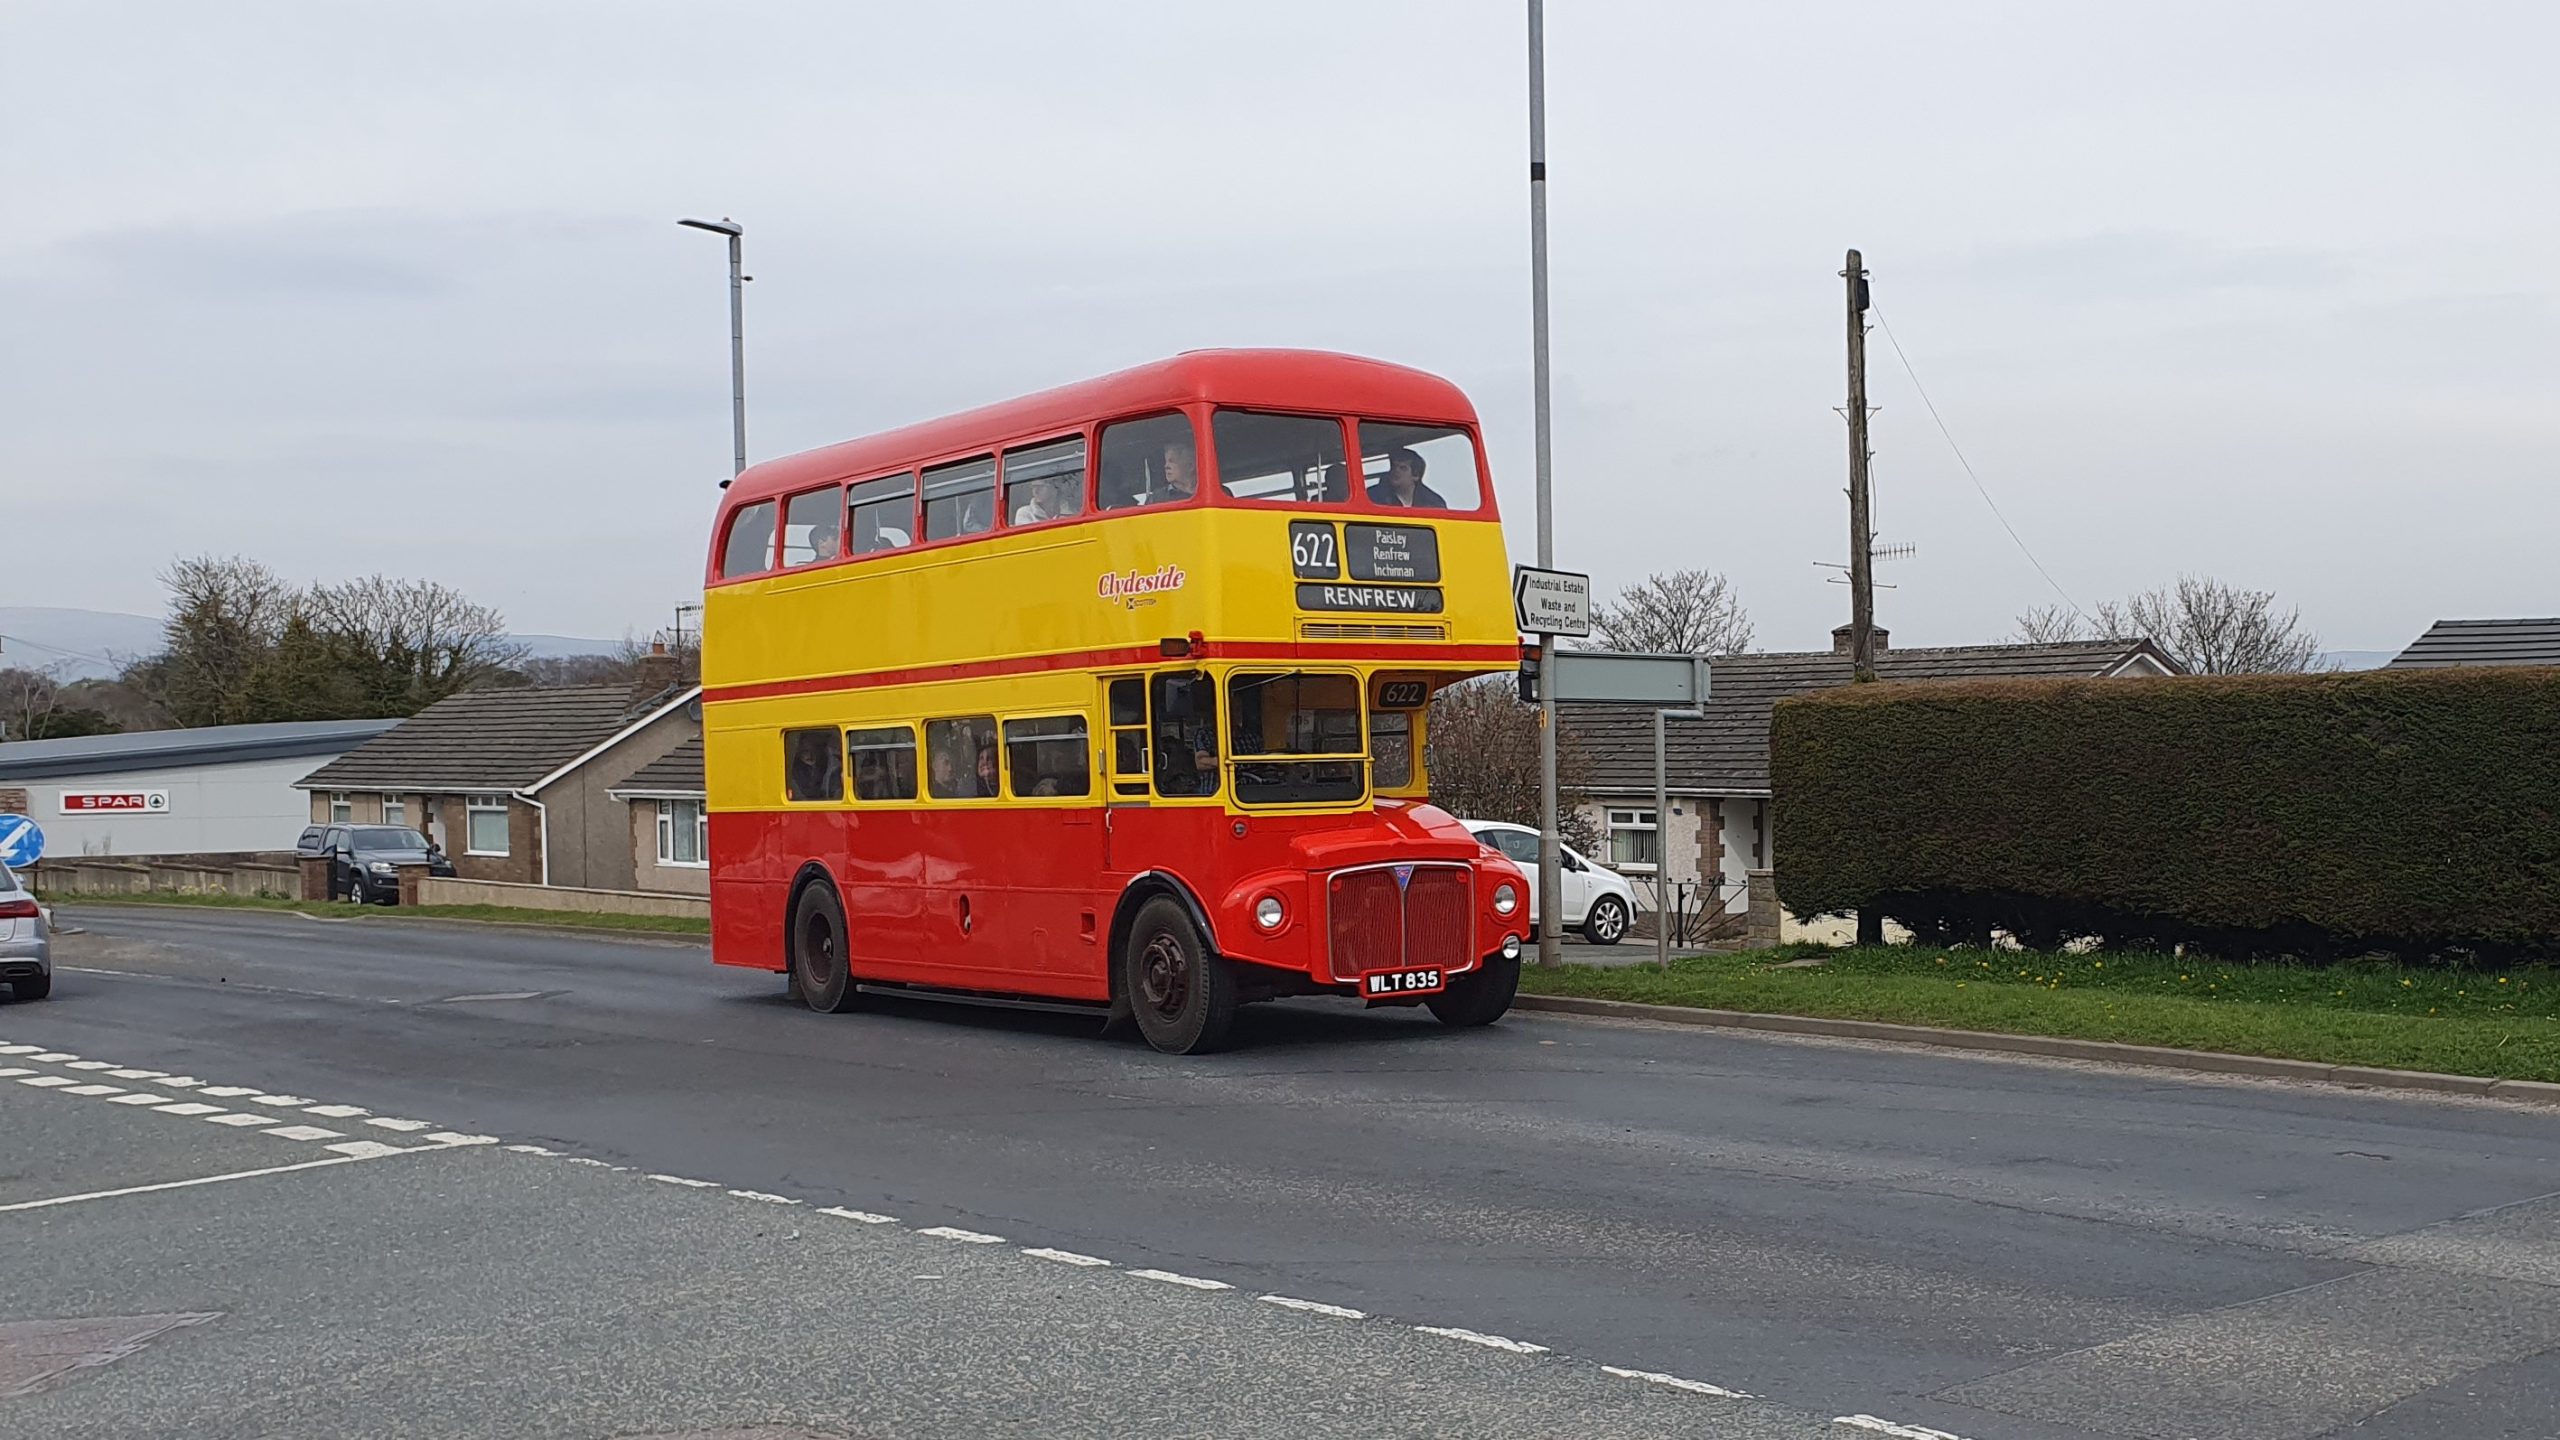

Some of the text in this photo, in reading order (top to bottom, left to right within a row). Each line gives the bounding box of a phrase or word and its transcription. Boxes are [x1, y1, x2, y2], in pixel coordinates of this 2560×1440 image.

[1375, 530, 1407, 549] Paisley
[1293, 533, 1337, 567] 622
[1373, 546, 1410, 560] Renfrew
[1373, 562, 1415, 578] Inchinnan
[1098, 564, 1185, 604] Clydeside
[1529, 576, 1584, 594] Industrial Estate
[1324, 586, 1416, 609] RENFREW
[1540, 597, 1576, 613] Waste and
[1530, 613, 1586, 630] Recycling Centre
[1386, 683, 1420, 703] 622
[82, 796, 143, 808] SPAR
[1369, 970, 1438, 993] WLT 835
